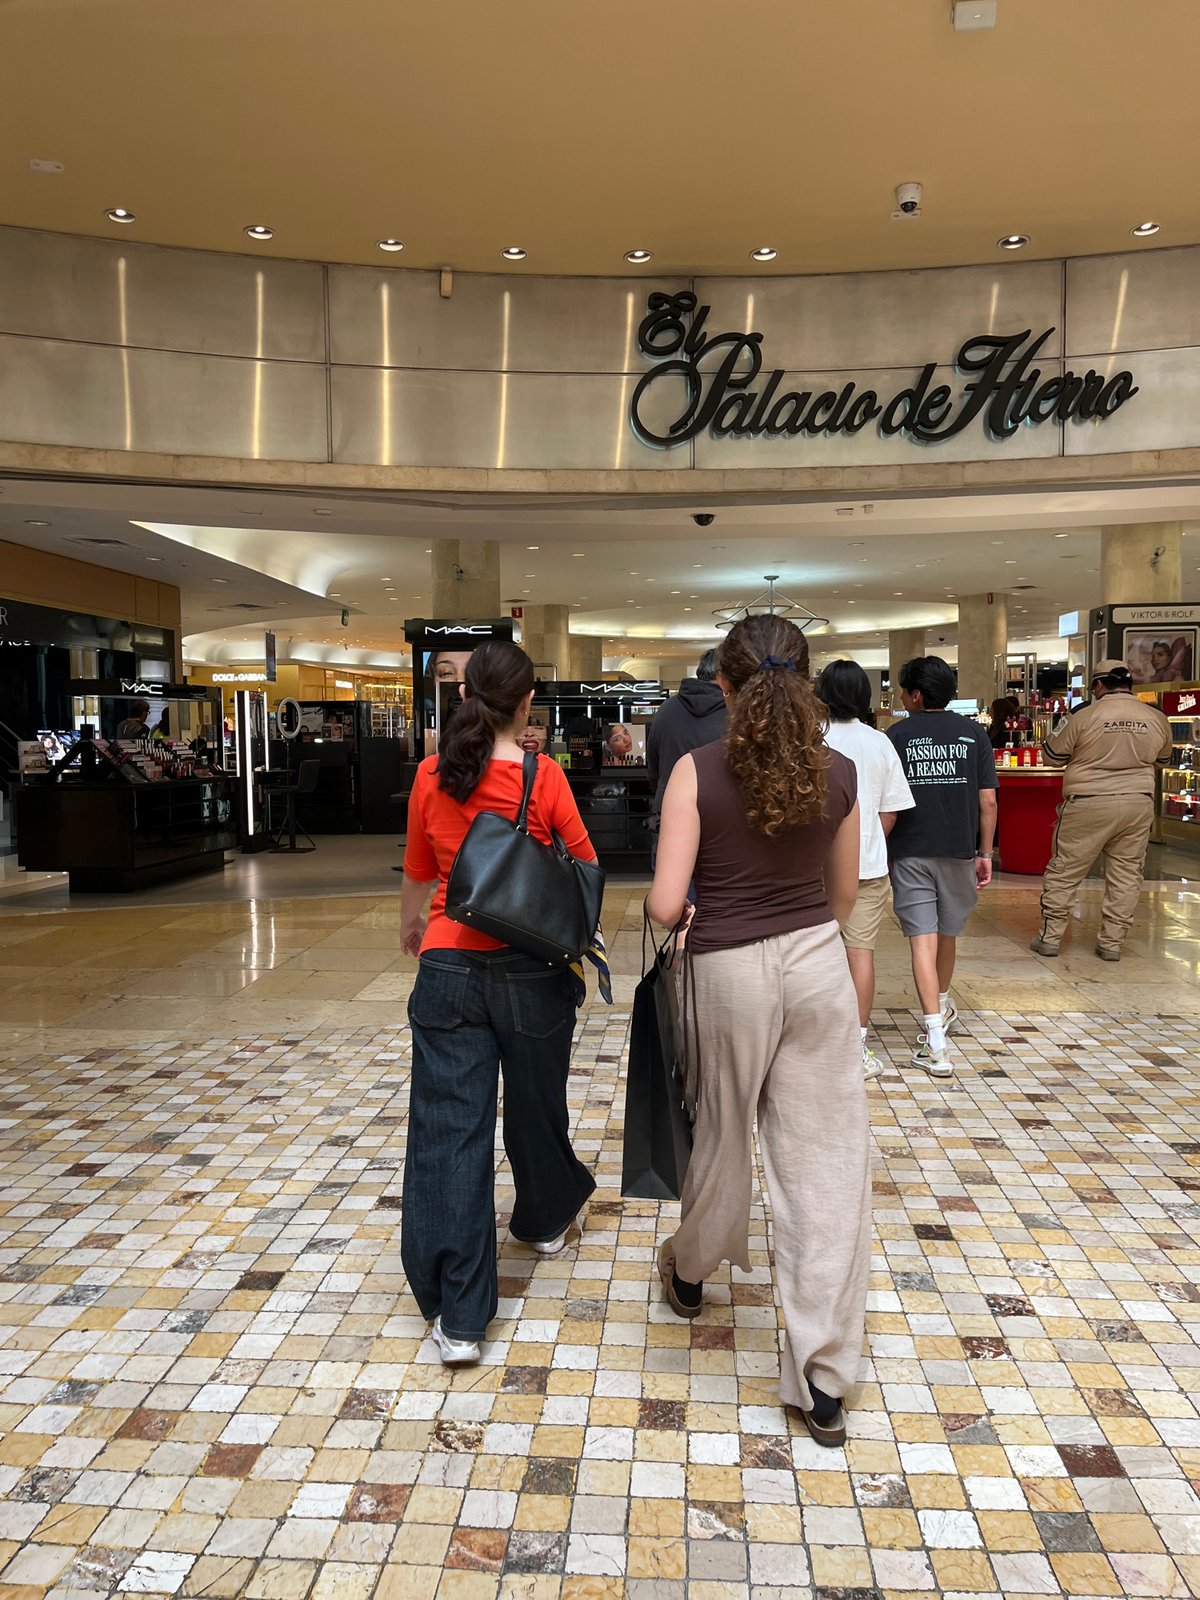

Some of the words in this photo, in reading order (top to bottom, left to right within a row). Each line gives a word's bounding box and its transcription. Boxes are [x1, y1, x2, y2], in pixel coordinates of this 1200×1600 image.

[638, 291, 711, 358] El
[632, 332, 884, 446] Palacio
[913, 327, 1139, 442] Hierro
[881, 362, 951, 435] de
[1131, 611, 1163, 619] VIKTOR
[1171, 610, 1195, 619] ROLF
[1103, 721, 1148, 729] ZASCITA
[908, 737, 933, 747] create
[905, 744, 948, 762] PASSION
[949, 743, 968, 760] FOR
[907, 763, 914, 778] A
[916, 760, 956, 777] REASON
